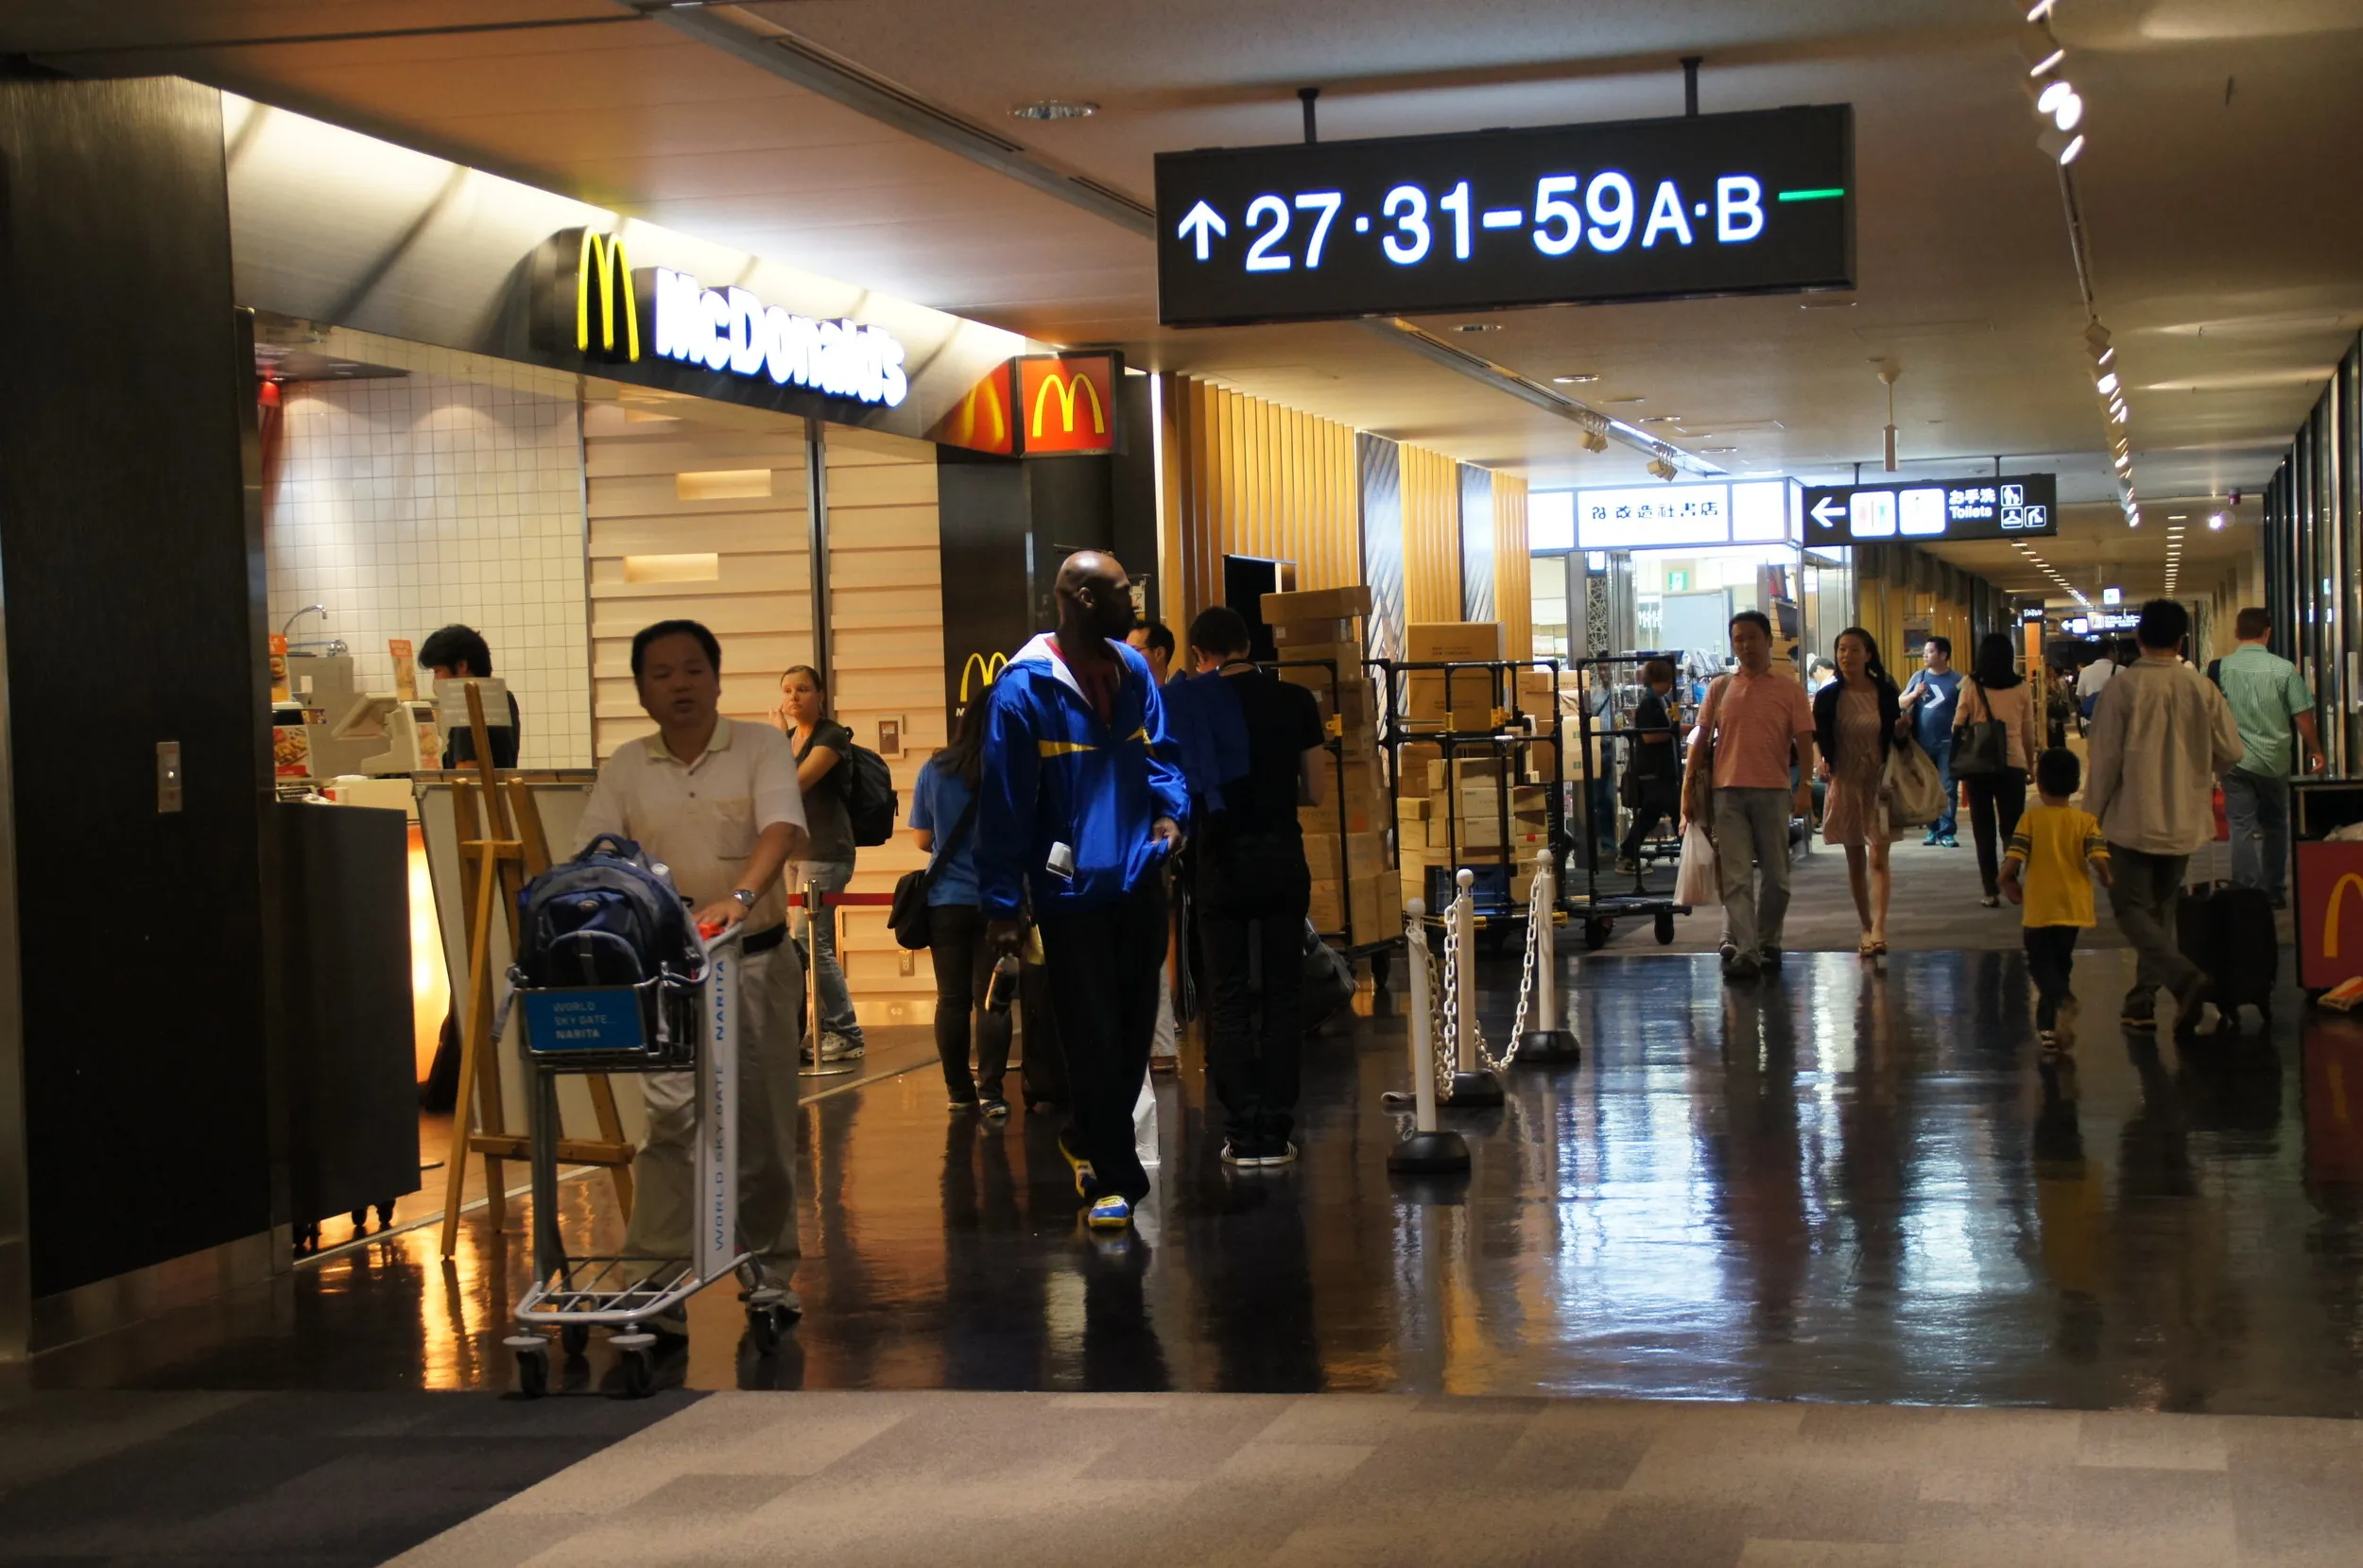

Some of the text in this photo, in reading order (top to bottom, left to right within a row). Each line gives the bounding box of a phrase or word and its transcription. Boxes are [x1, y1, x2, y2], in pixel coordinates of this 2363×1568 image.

[656, 267, 907, 407] McDonald's
[1949, 488, 1996, 505] お手洗
[1949, 506, 1992, 519] Toilets
[553, 1002, 595, 1012] WORLD
[716, 960, 724, 1041] NARITA
[554, 1016, 576, 1025] SKY
[556, 1028, 600, 1039] NARITA
[716, 1122, 724, 1162] SKY
[716, 1172, 724, 1250] WORLD
